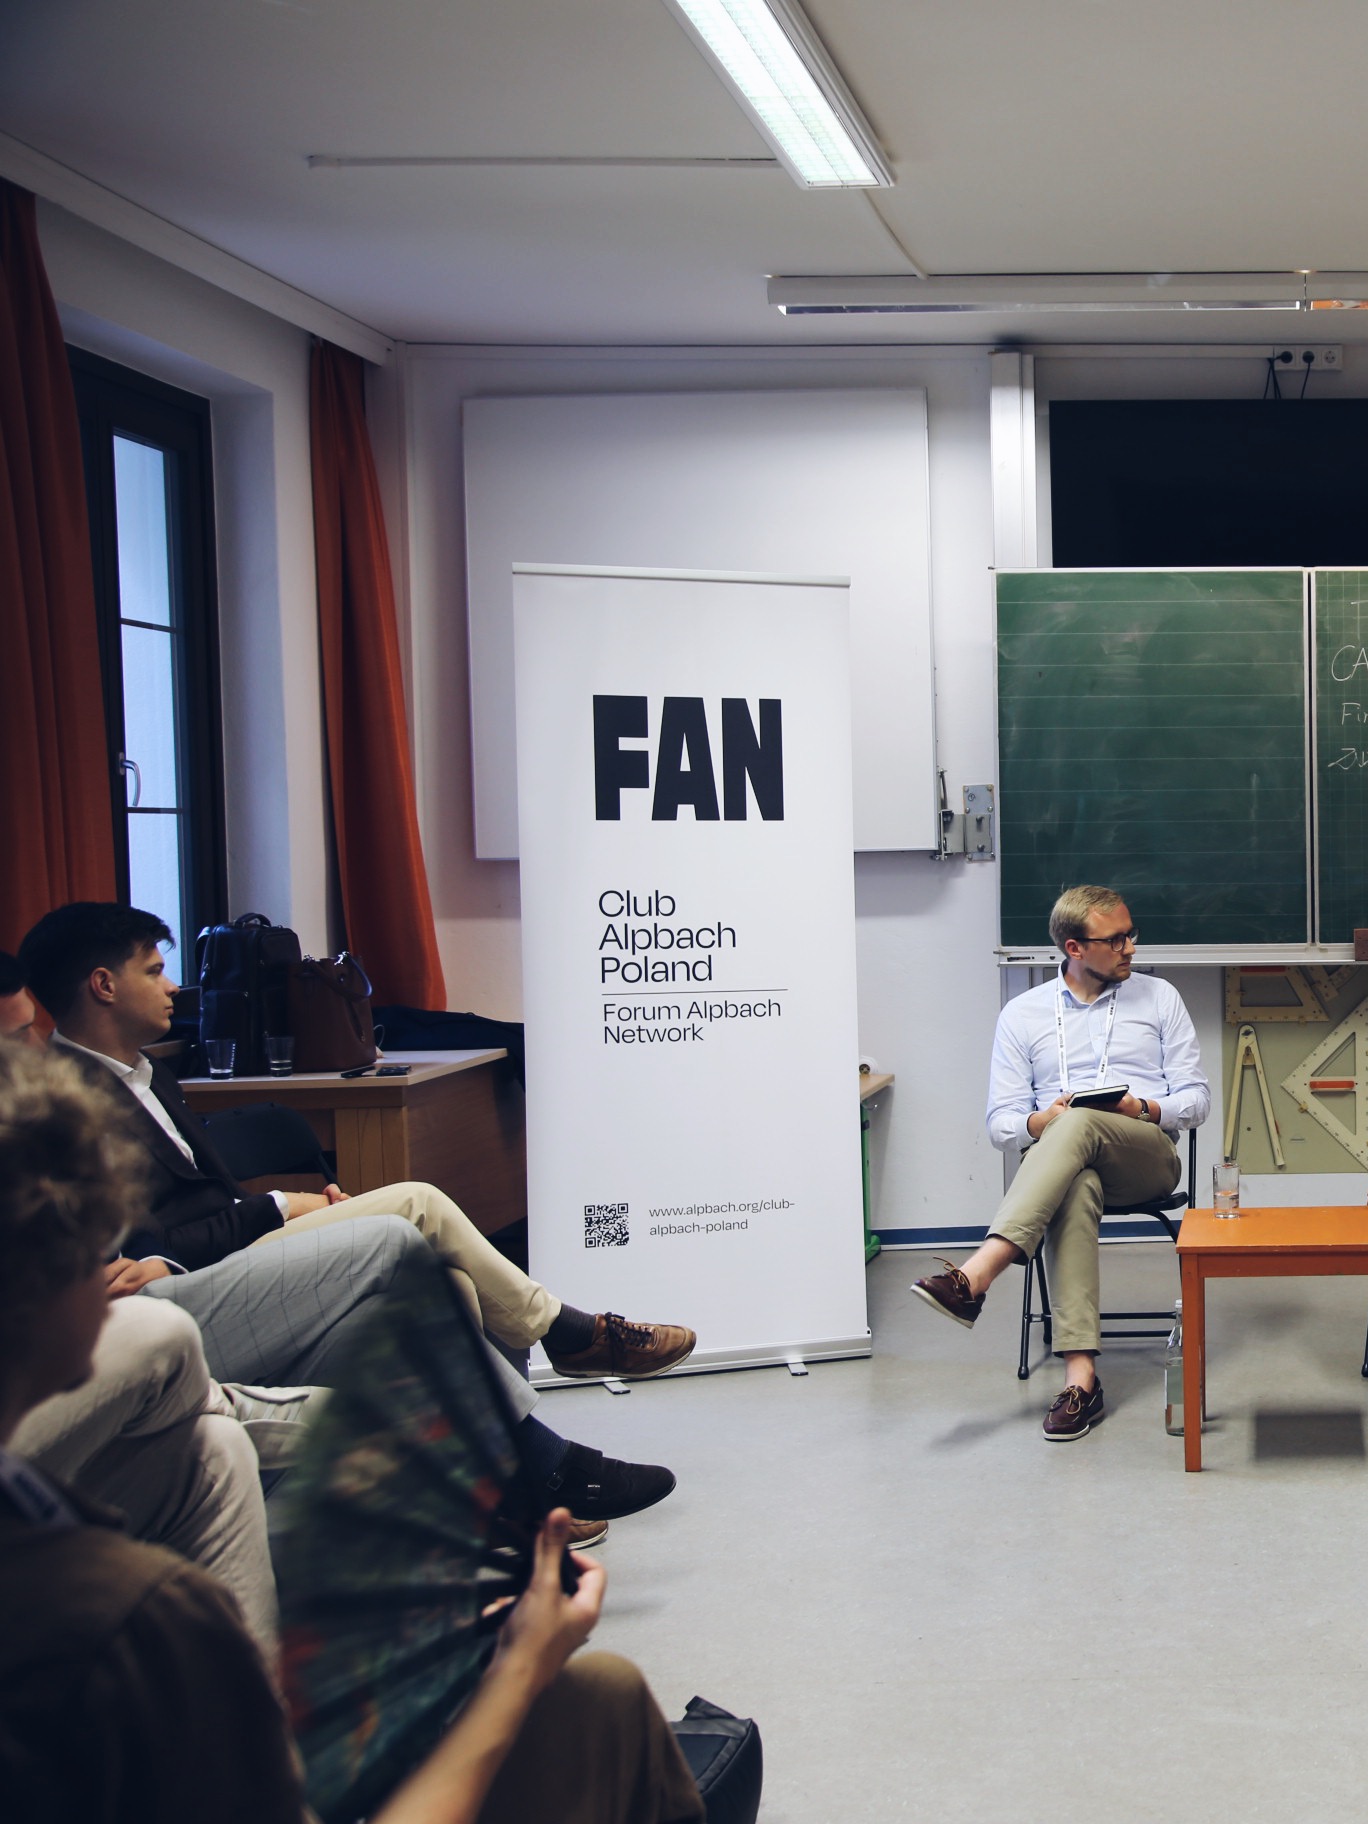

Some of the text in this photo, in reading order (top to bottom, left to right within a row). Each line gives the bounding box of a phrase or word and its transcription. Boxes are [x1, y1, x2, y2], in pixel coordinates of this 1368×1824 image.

[593, 694, 785, 821] FAN
[598, 889, 676, 918] Club
[598, 921, 737, 956] Alpbach
[601, 954, 713, 984] Poland
[603, 998, 782, 1023] Forum Alpbach
[604, 1023, 704, 1044] Network
[649, 1198, 796, 1218] www.alpbach.org/club-
[649, 1218, 749, 1237] alpbach-poland
